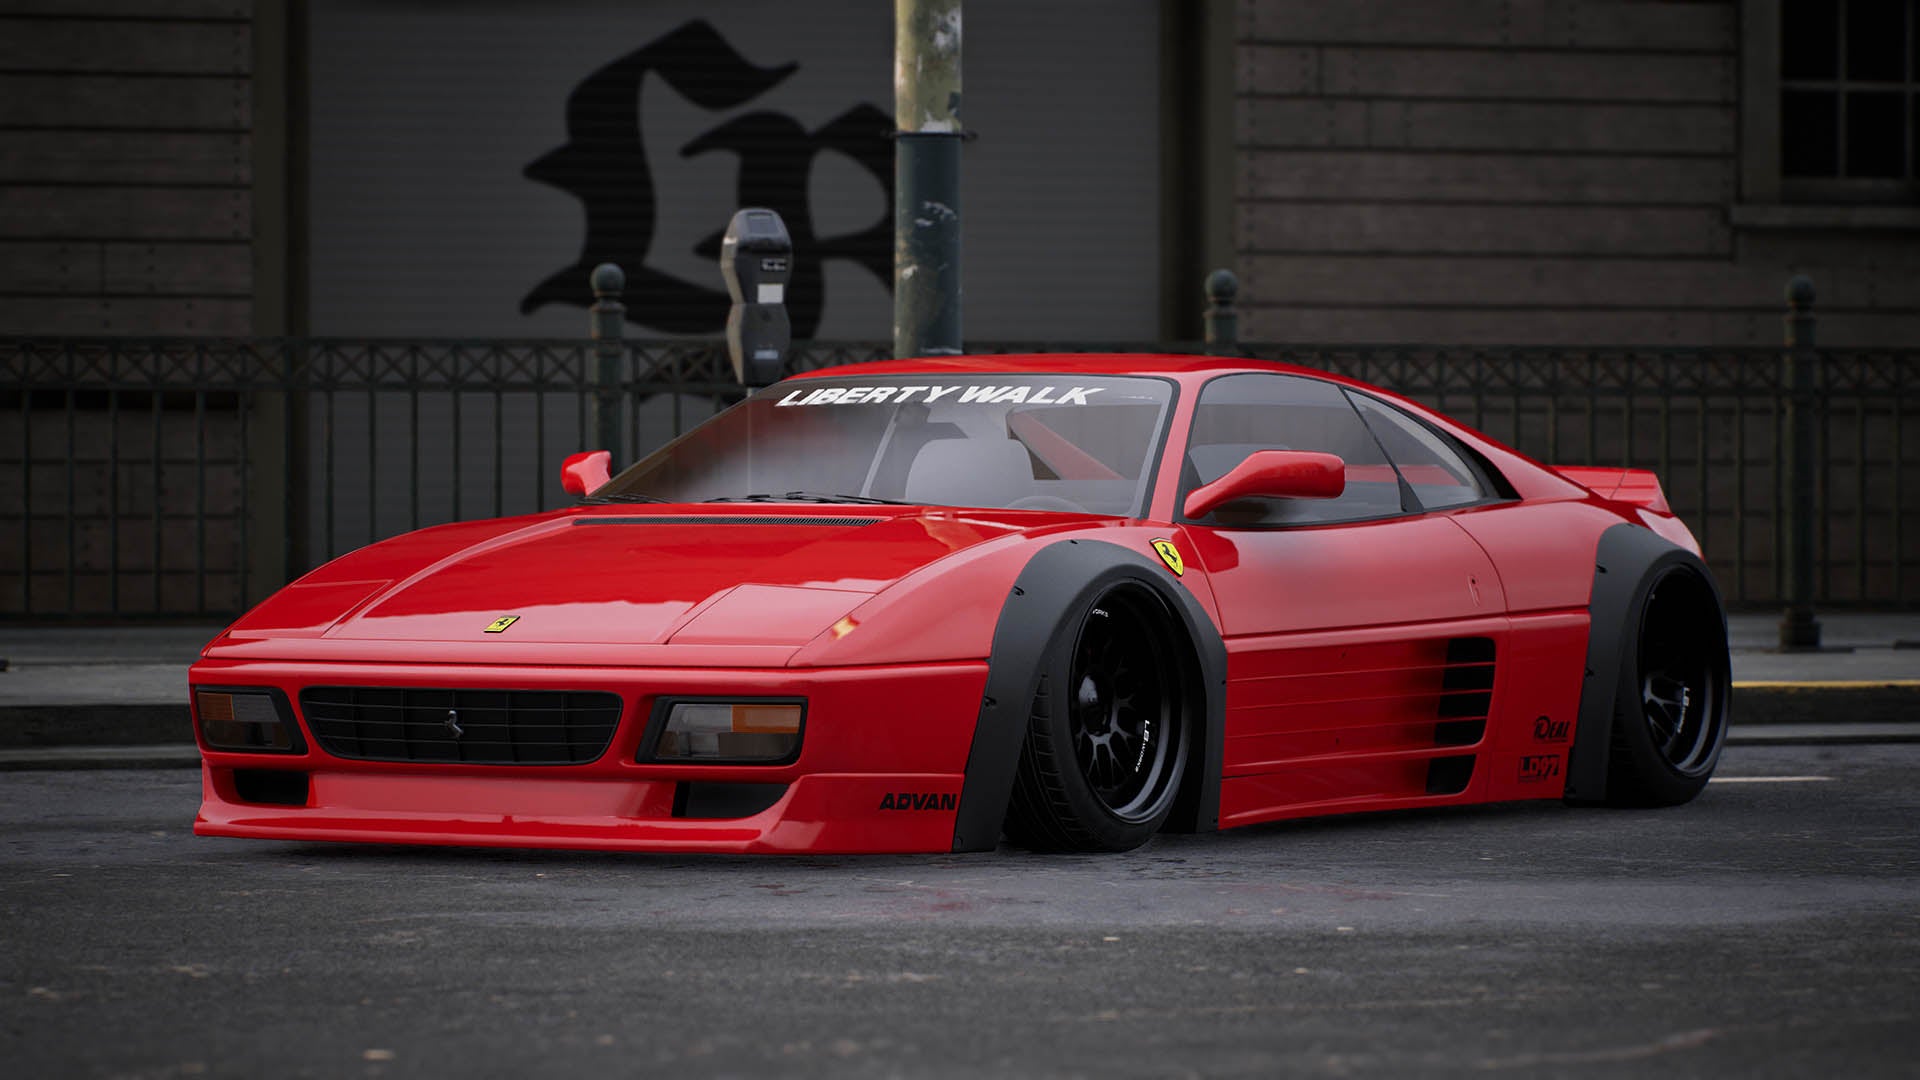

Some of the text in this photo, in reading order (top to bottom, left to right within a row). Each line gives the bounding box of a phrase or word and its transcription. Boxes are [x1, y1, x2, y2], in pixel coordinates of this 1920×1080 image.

[774, 385, 1107, 407] LIBERTY WALK
[879, 792, 957, 811] ADVAN
